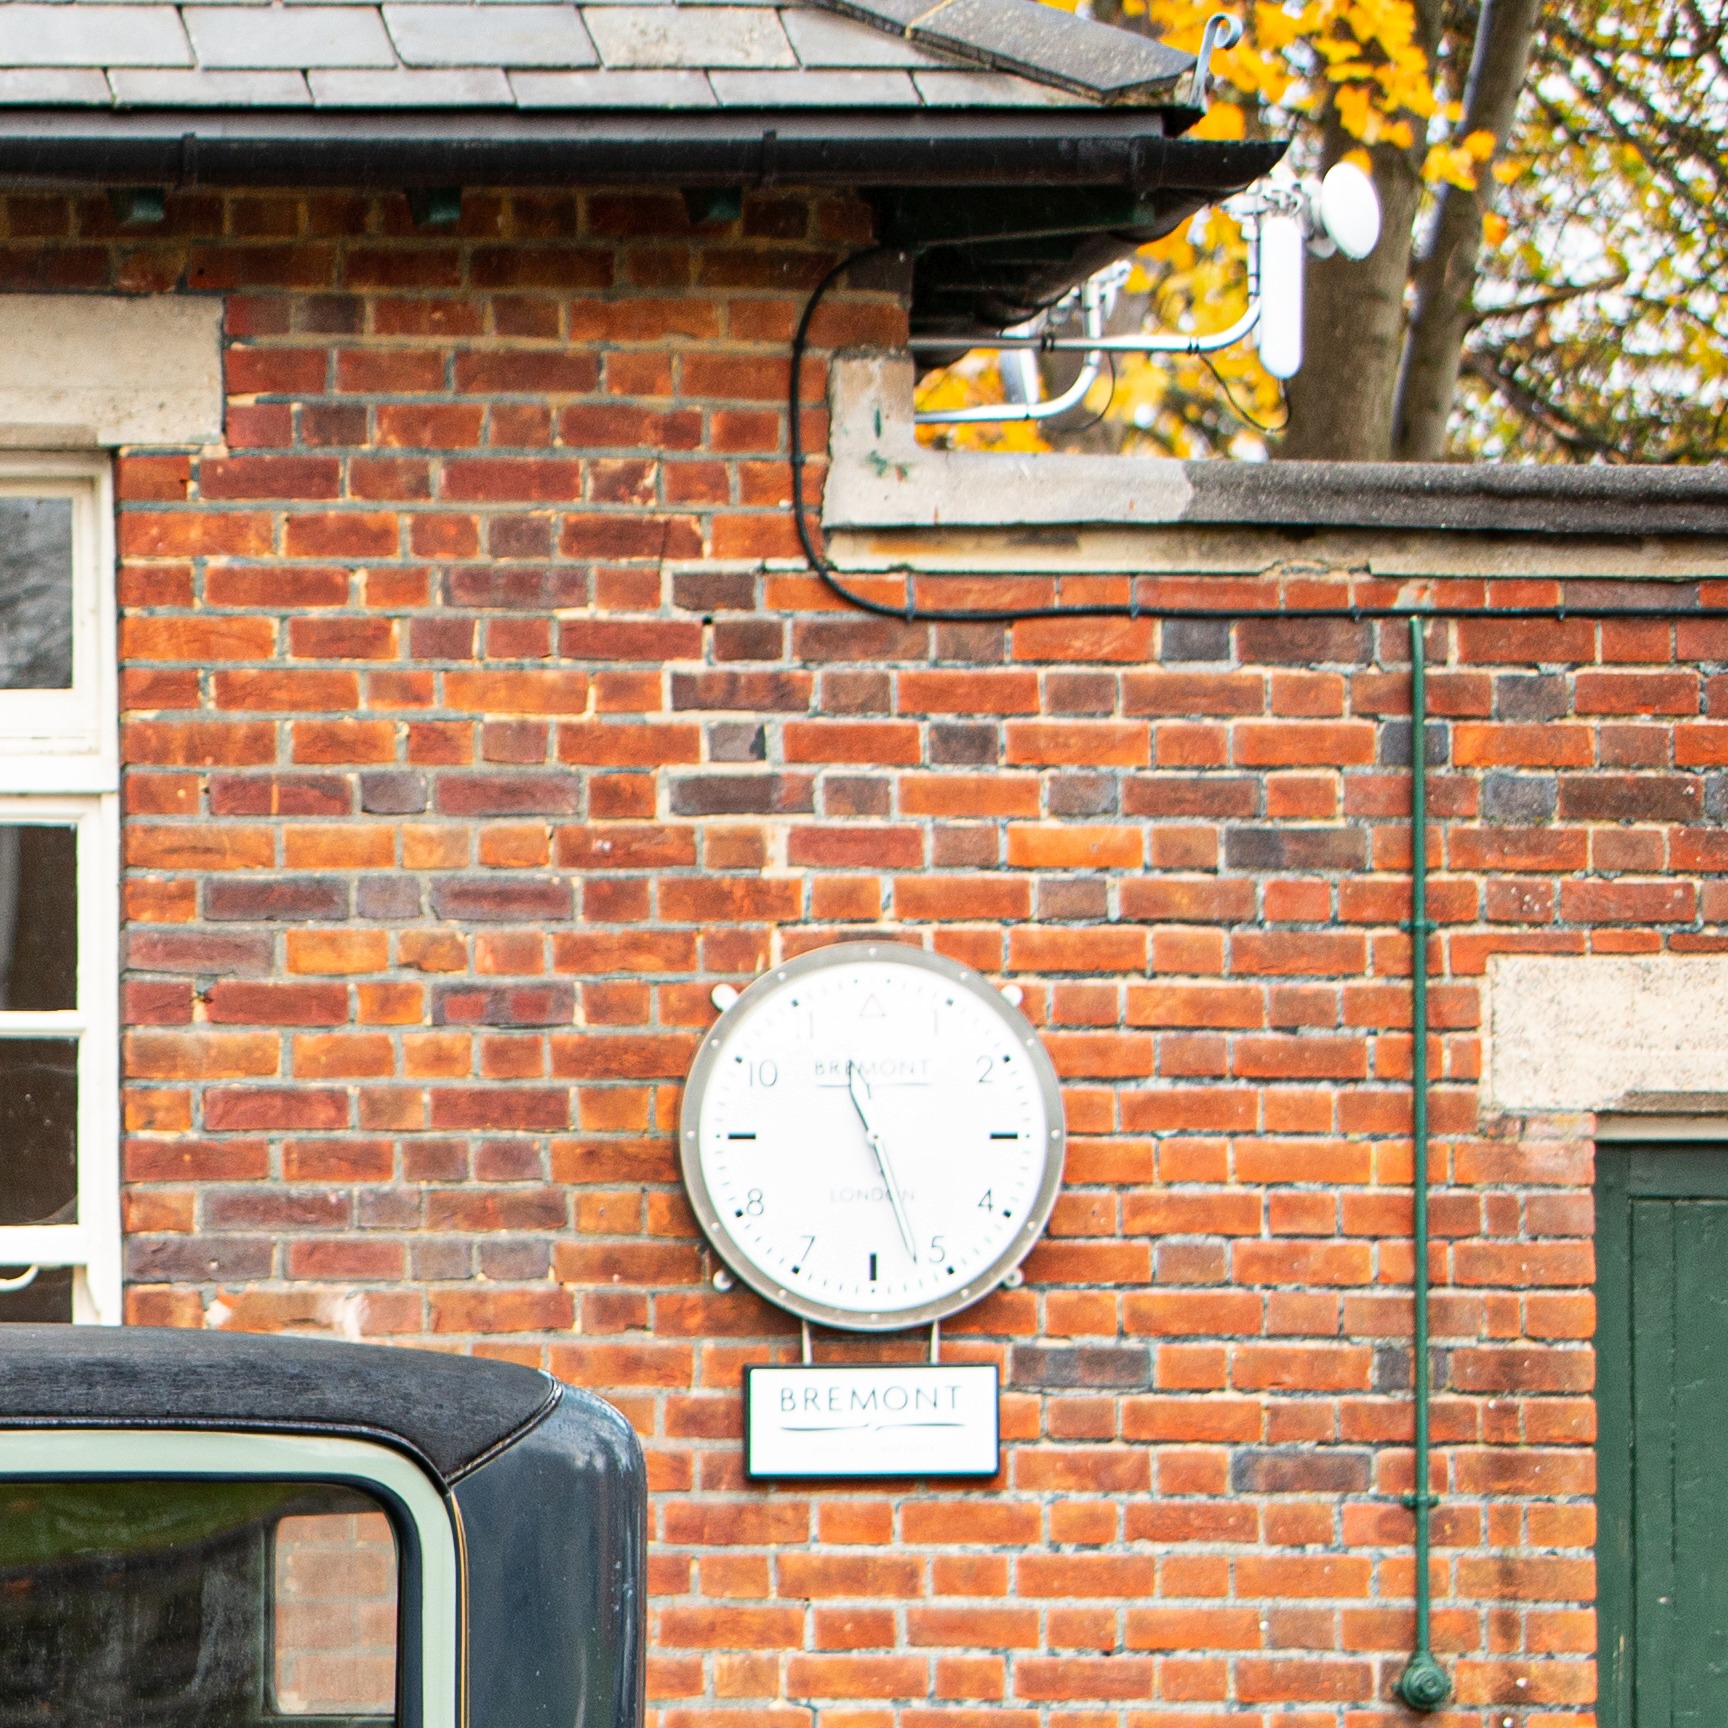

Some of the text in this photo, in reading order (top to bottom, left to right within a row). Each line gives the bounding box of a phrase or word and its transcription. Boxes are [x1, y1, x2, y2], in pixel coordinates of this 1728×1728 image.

[747, 1058, 778, 1087] 10
[976, 1056, 995, 1085] 2
[746, 1188, 765, 1218] 8
[830, 1187, 915, 1202] LONDN
[976, 1187, 995, 1214] 4
[799, 1234, 817, 1264] 7
[928, 1234, 946, 1264] 5
[780, 1386, 961, 1412] BREMONT
